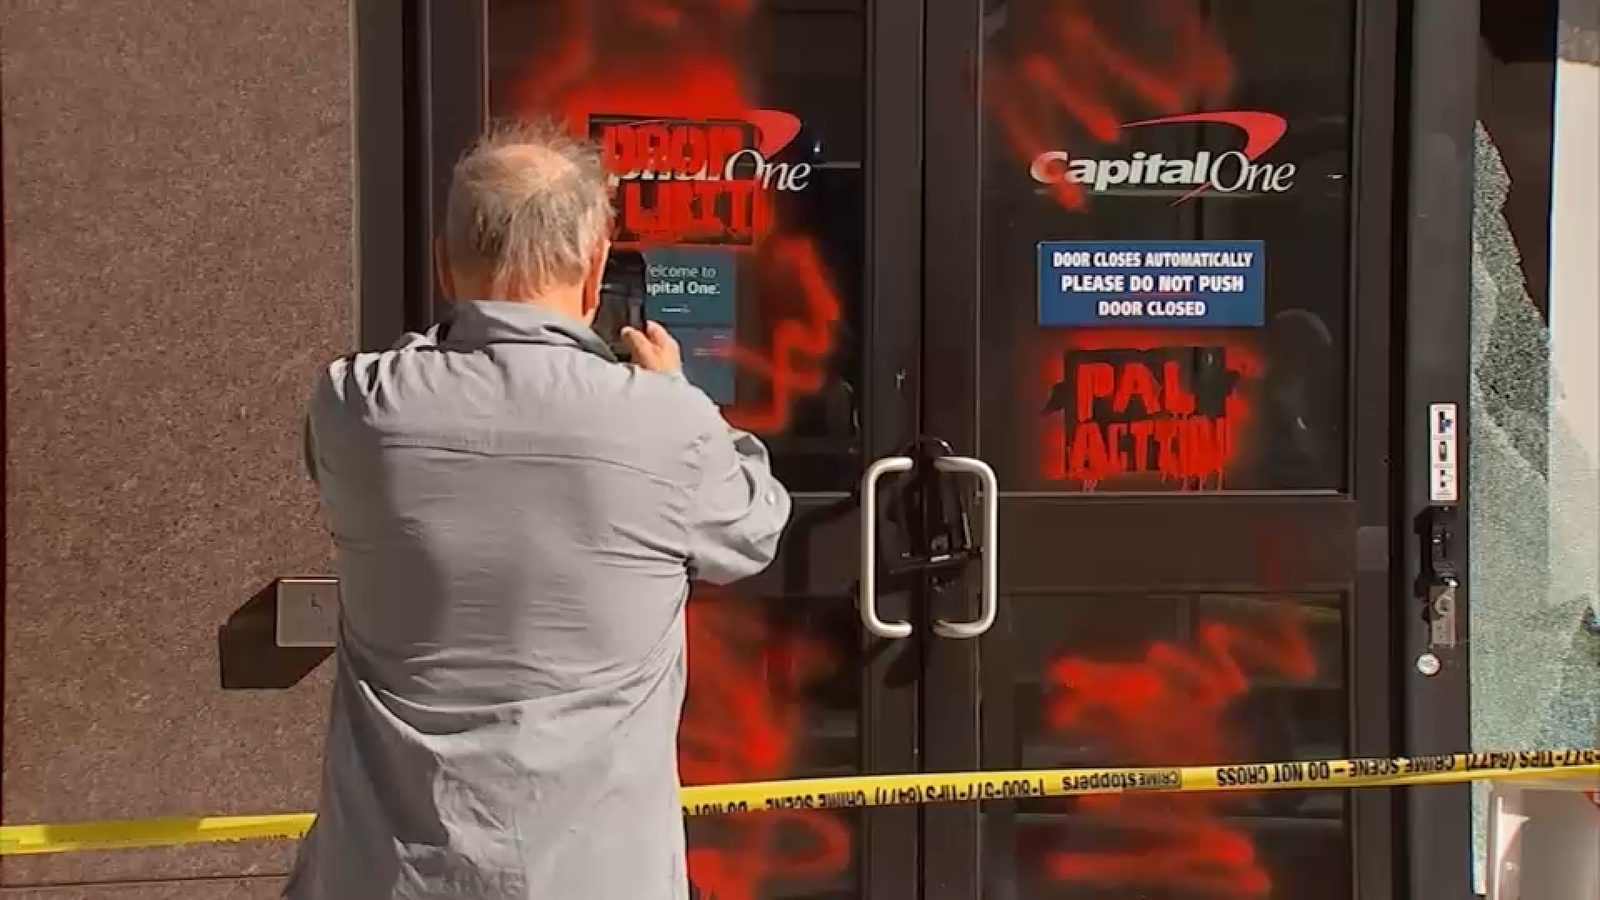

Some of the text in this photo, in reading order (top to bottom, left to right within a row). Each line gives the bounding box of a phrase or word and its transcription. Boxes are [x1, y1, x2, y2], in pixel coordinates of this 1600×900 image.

[1053, 252, 1253, 267] DOOR CLOSES AUTOMATICALLY
[646, 264, 716, 278] elcome to
[646, 280, 684, 297] pital
[1061, 275, 1244, 292] PLEASE DO NOT PUSH
[1098, 301, 1206, 316] DOOR CLOSED
[1076, 361, 1196, 423] PAL
[1308, 762, 1330, 780] DO
[1348, 758, 1398, 777] SCENE
[1405, 753, 1455, 773] CRIME
[1217, 765, 1269, 786] CROSS
[1273, 763, 1303, 782] NOT
